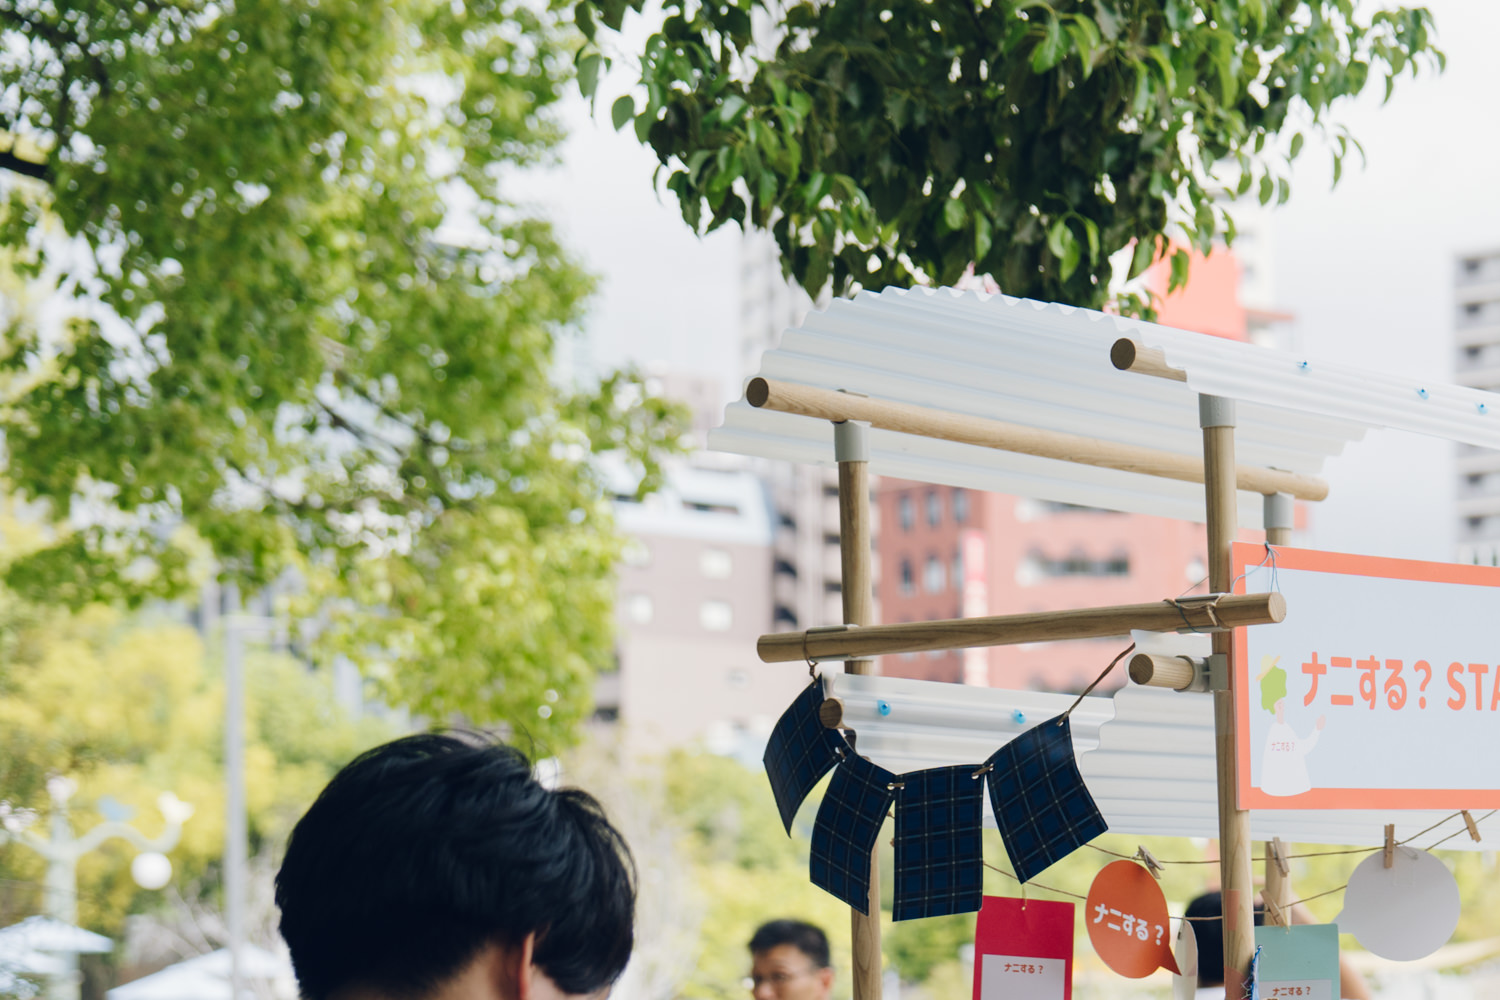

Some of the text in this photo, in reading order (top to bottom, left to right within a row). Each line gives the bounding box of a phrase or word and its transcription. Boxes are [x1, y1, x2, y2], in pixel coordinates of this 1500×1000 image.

[1301, 651, 1433, 711] ナニする？
[1092, 903, 1165, 946] ナニする？
[1003, 962, 1045, 975] ナニする？
[1272, 986, 1311, 997] ナニする？
